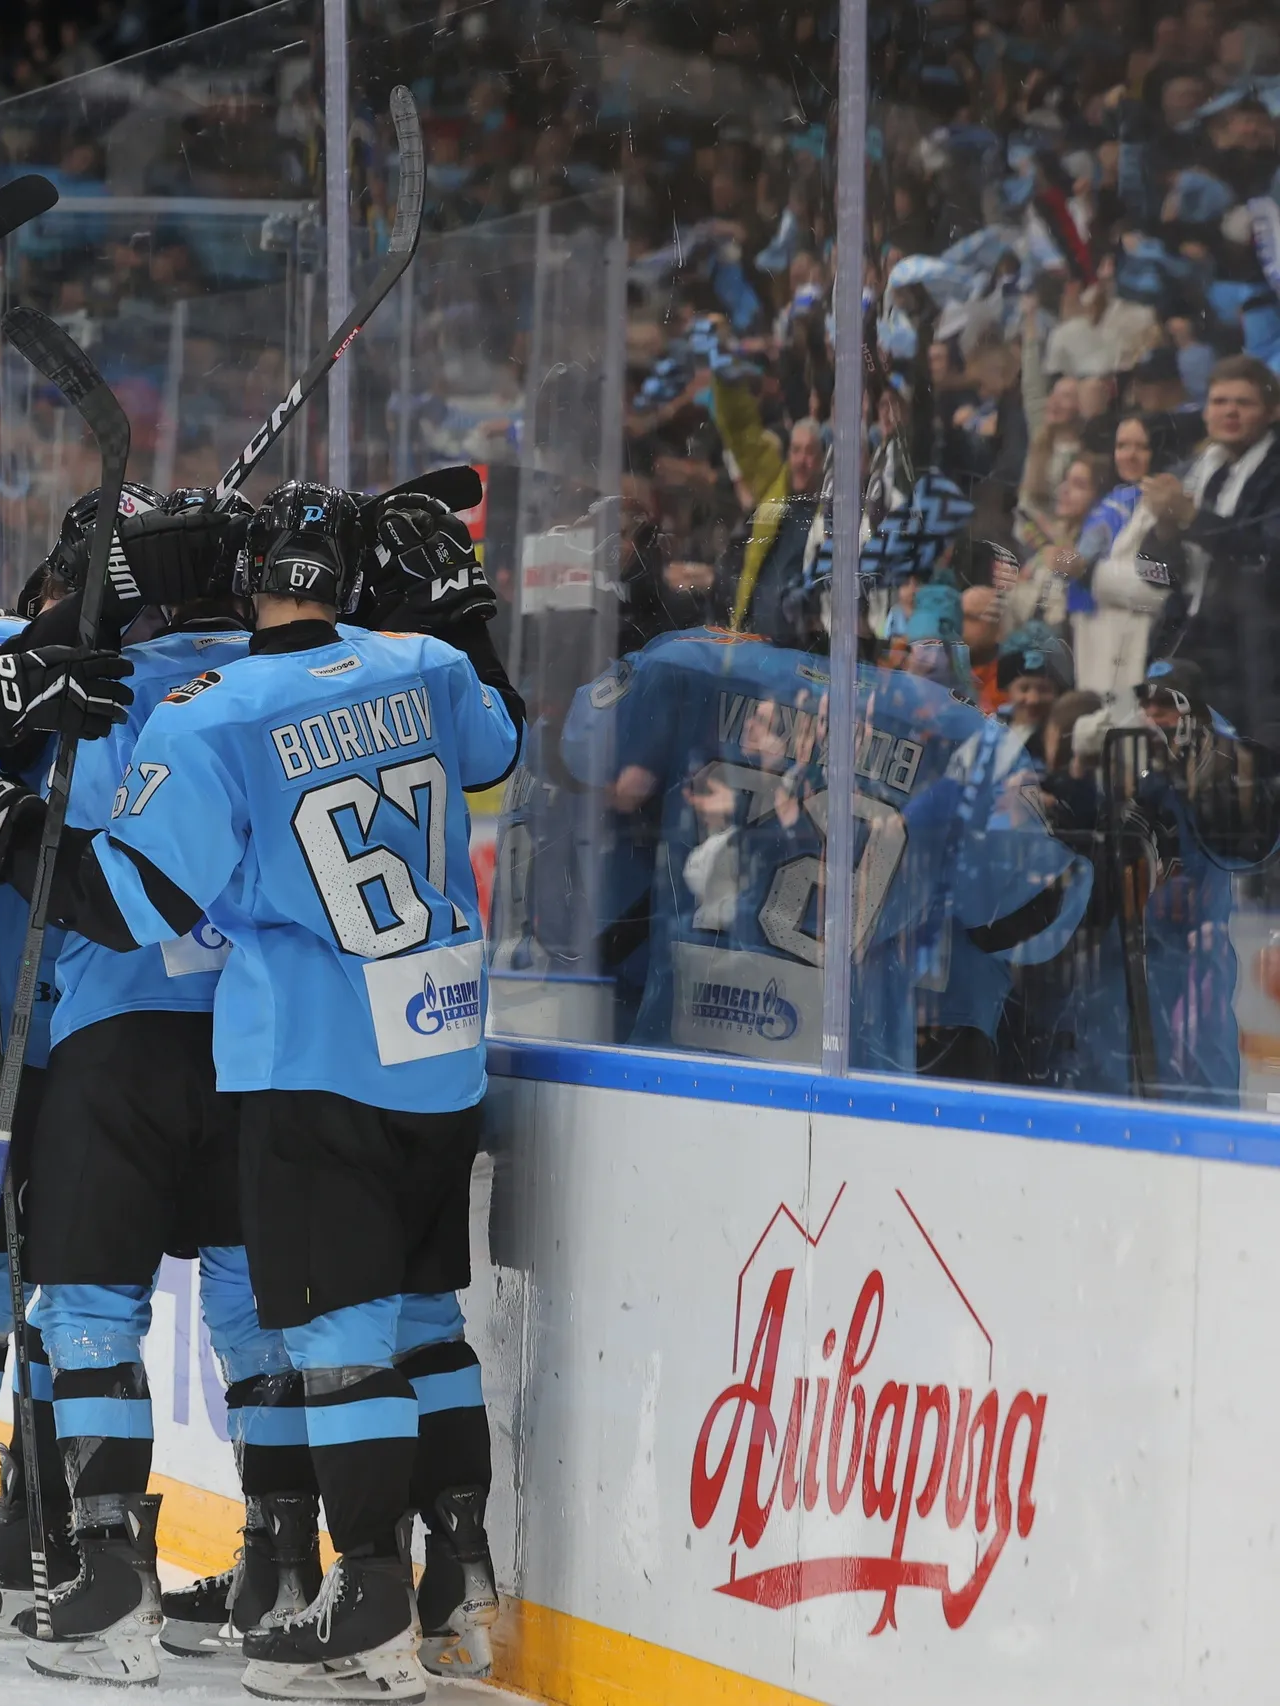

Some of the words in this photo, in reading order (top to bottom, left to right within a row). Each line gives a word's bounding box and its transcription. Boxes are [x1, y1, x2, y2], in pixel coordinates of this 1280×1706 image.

[334, 328, 359, 359] CCM
[216, 380, 303, 500] CCM
[290, 562, 320, 589] 67
[431, 566, 489, 601] CM
[271, 686, 434, 781] BORIKOV
[110, 761, 171, 820] 67
[290, 752, 470, 960] 67
[439, 979, 479, 1007] ГАЗПРО
